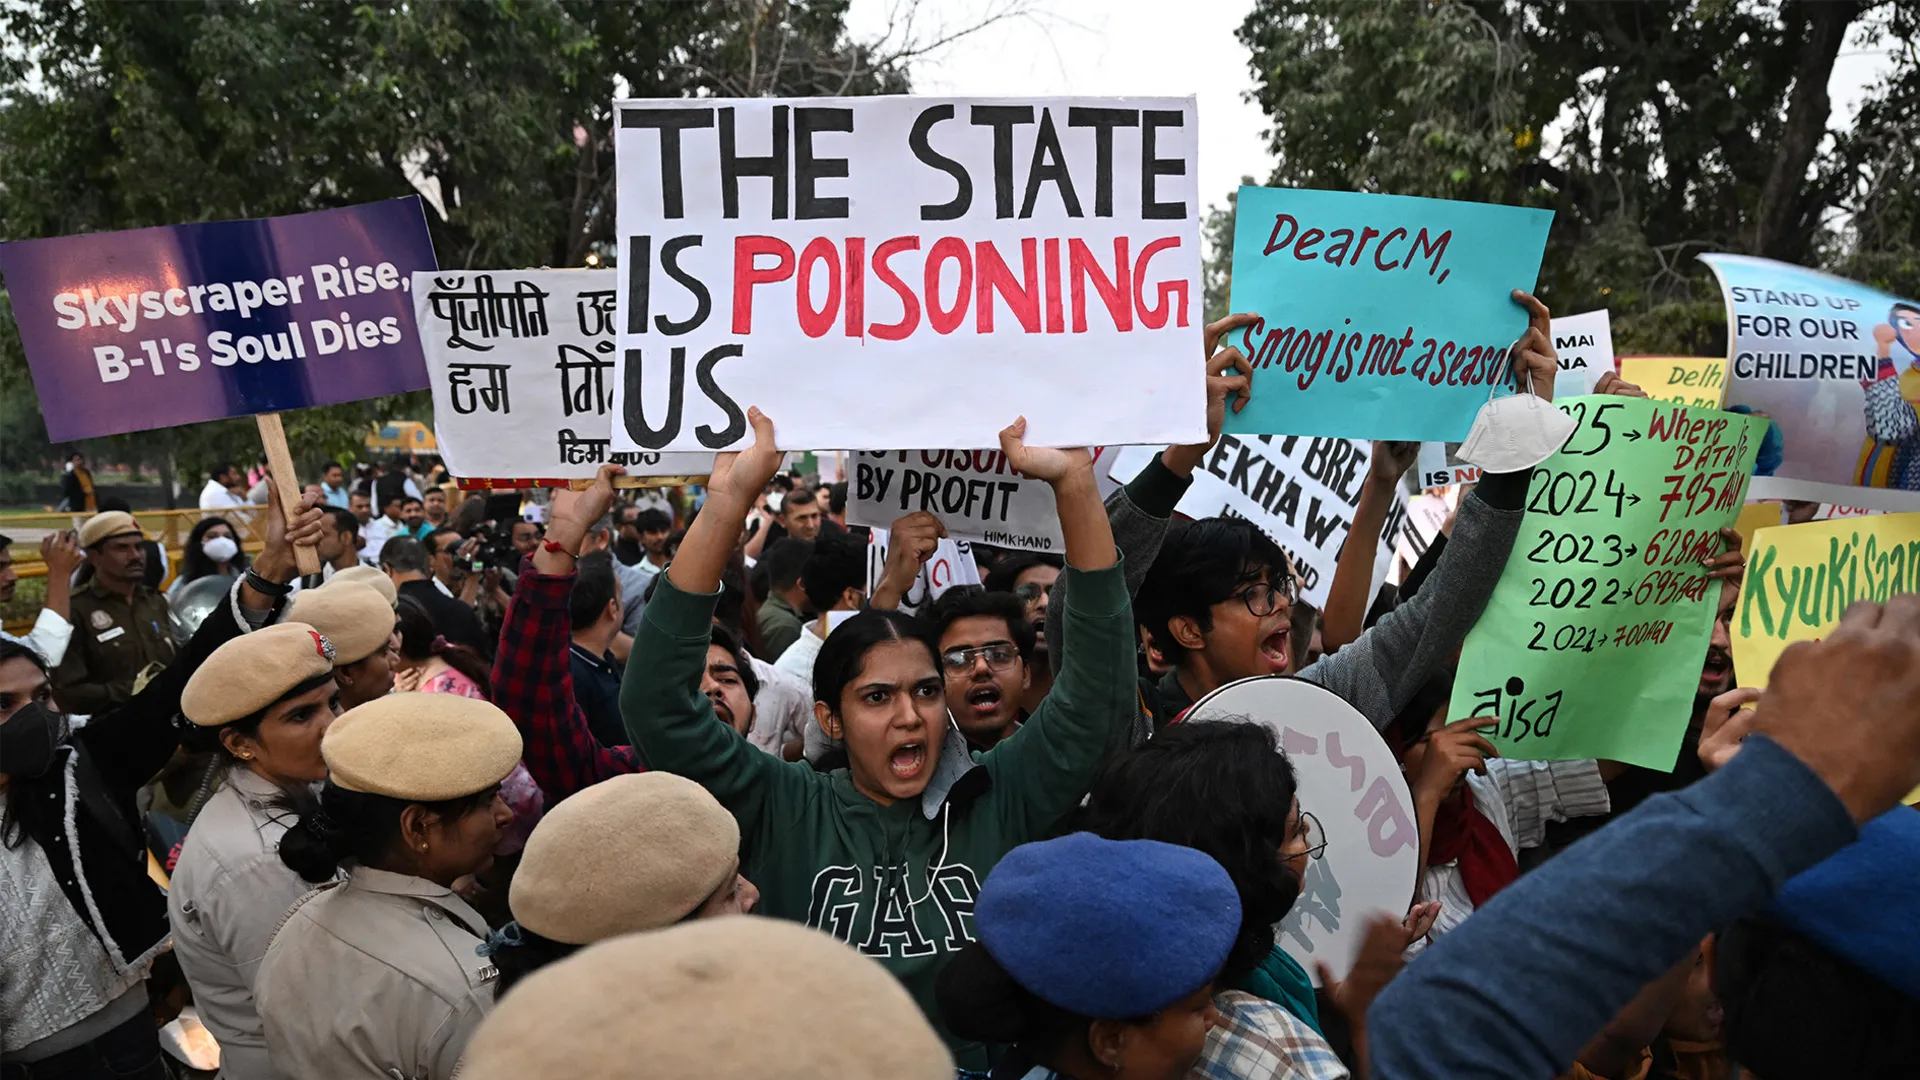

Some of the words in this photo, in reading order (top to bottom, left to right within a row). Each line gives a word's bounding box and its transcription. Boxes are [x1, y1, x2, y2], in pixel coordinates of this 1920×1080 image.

[621, 105, 854, 219] THE
[908, 104, 1187, 220] STATE
[1263, 213, 1379, 268] Dear
[1374, 227, 1452, 285] CM,
[53, 273, 306, 332] Skyscraper
[311, 256, 411, 302] Rise,
[627, 234, 712, 336] IS
[731, 235, 1189, 346] POISONING
[1731, 285, 1818, 308] STAND
[1826, 299, 1861, 311] UP
[93, 339, 201, 384] B-1's
[206, 322, 306, 367] Soul
[309, 313, 402, 356] Dies
[1555, 334, 1595, 350] MAI
[1737, 315, 1792, 338] FOR
[1799, 316, 1860, 340] OUR
[1243, 316, 1334, 391] Smog
[1325, 317, 1363, 384] is
[1356, 326, 1415, 378] not
[1410, 337, 1438, 382] a
[1667, 363, 1724, 389] Delh
[1733, 353, 1878, 381] CHILDREN
[447, 362, 512, 415] हम
[623, 343, 746, 450] US
[1648, 407, 1729, 447] Where
[857, 463, 894, 503] BY
[900, 469, 1019, 522] PROFIT
[1195, 433, 1303, 528] EKHA
[1425, 471, 1450, 487] IS
[1527, 469, 1625, 518] 2024
[984, 530, 1052, 550] HIMKHAND
[1527, 529, 1624, 567] 2023
[1529, 577, 1621, 608] 2022
[1527, 621, 1597, 653] 2021
[1469, 676, 1563, 743] aisa
[805, 863, 982, 958] GAP
